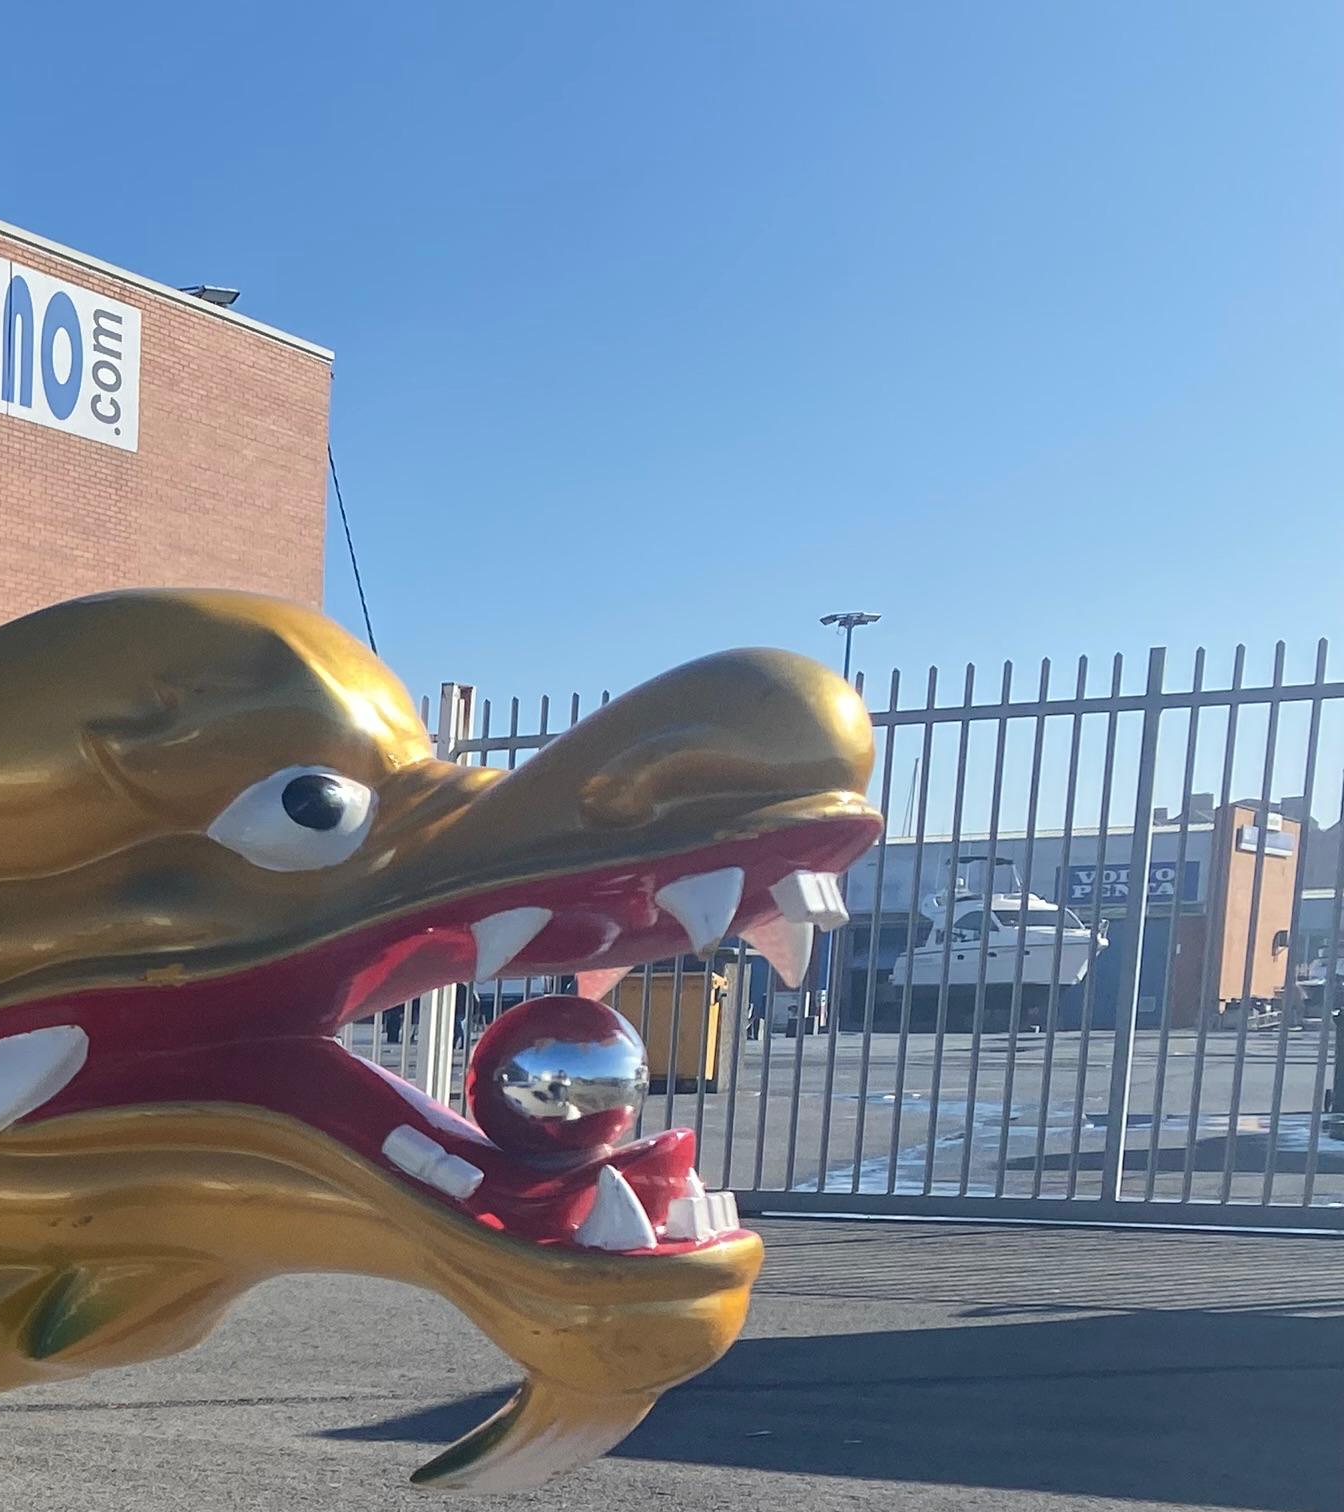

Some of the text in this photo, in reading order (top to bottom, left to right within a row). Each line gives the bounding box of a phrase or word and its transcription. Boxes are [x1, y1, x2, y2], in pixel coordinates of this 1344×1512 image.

[91, 308, 123, 436] .com
[1075, 867, 1176, 884] VOLO
[1072, 882, 1175, 898] PENA
